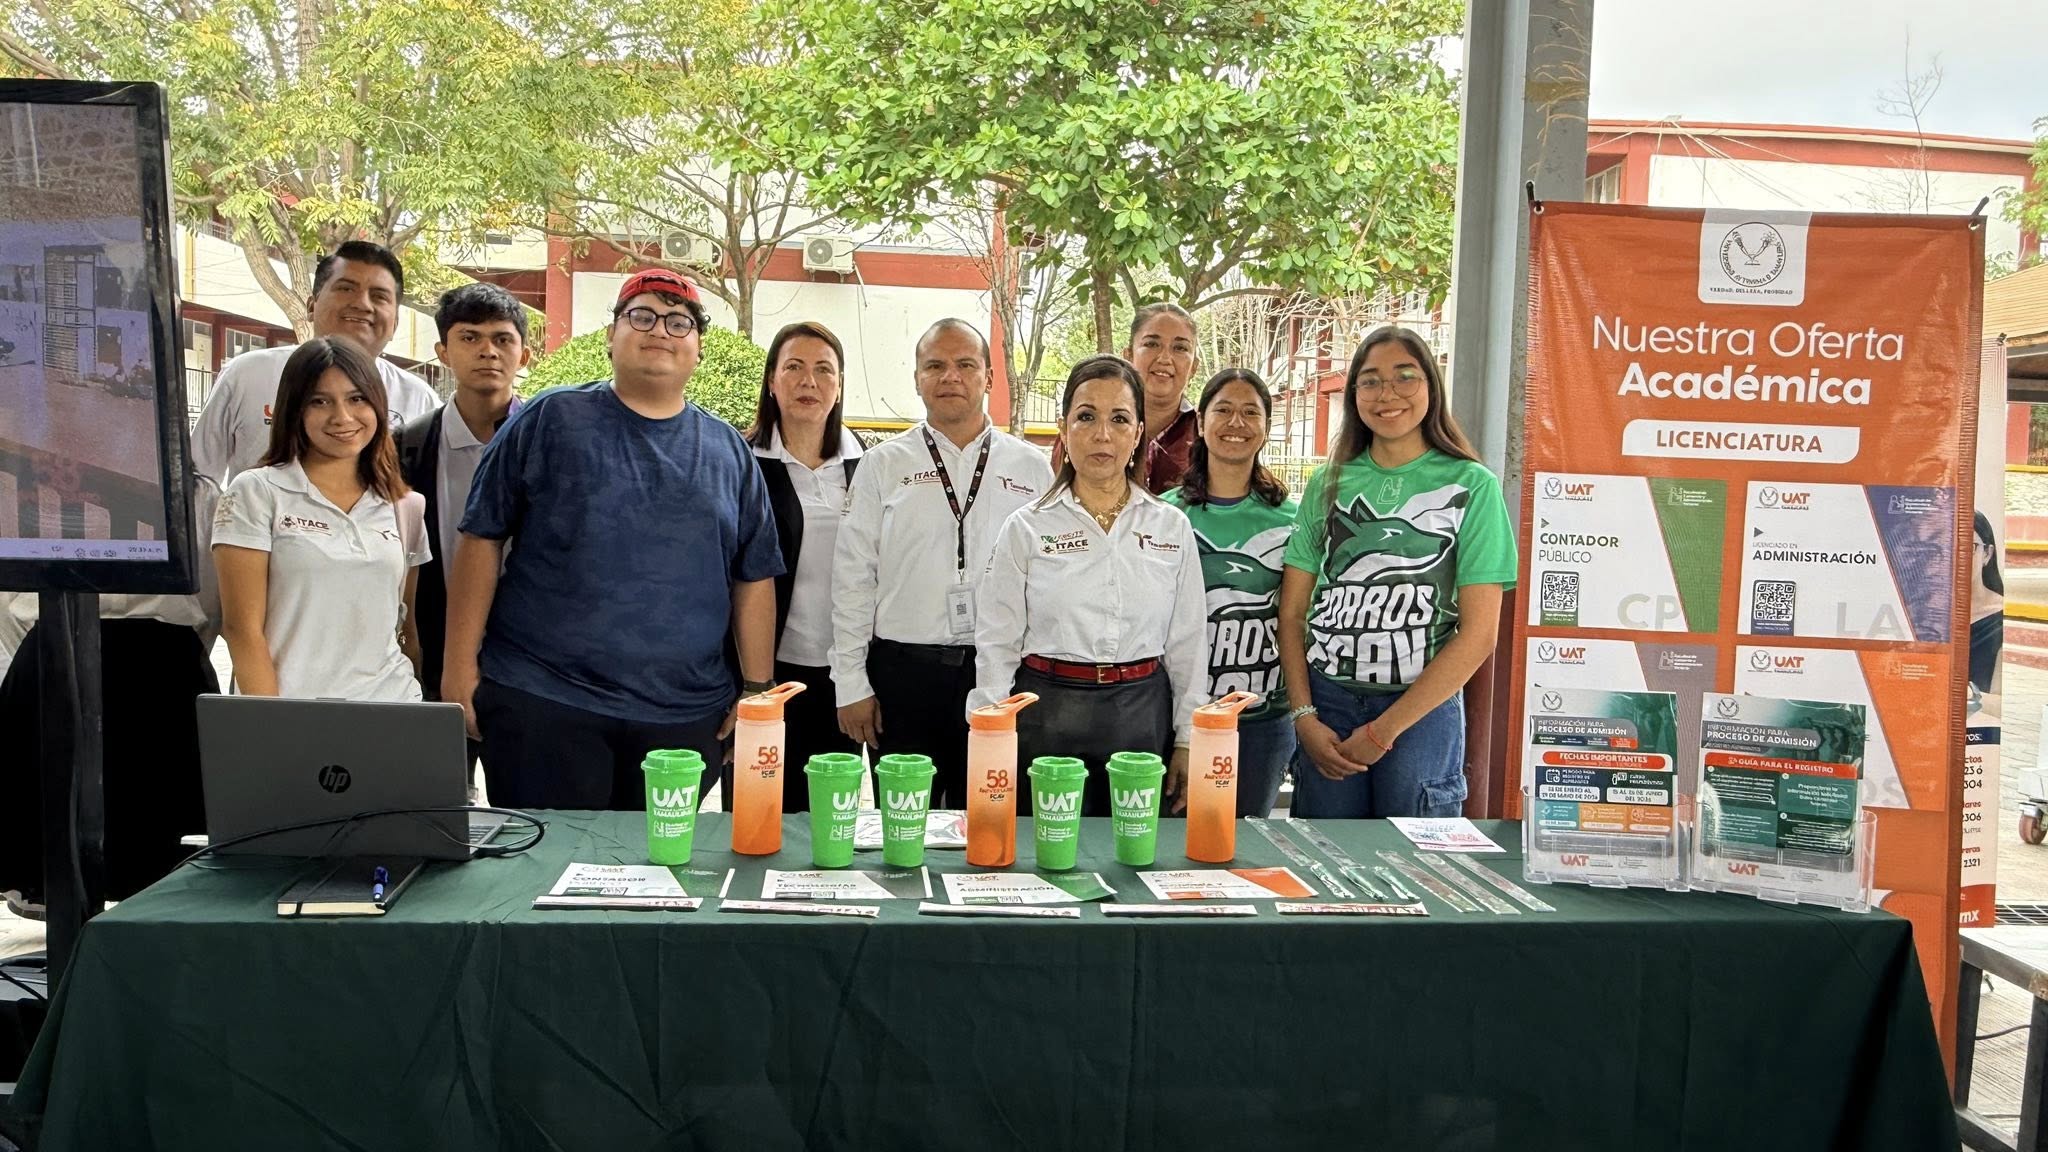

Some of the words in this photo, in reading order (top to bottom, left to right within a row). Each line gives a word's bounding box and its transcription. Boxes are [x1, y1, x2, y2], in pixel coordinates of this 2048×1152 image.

[1593, 315, 1755, 357] Nuestra
[1769, 321, 1904, 361] Oferta
[1617, 362, 1871, 405] Académica
[1655, 429, 1823, 453] LICENCIATURA
[1564, 483, 1594, 495] UAT
[1781, 492, 1811, 504] UAT
[1056, 539, 1089, 550] ITACE
[1540, 533, 1619, 548] CONTADOR
[1538, 547, 1592, 564] PÚBLICO
[1752, 550, 1877, 565] ADMINISTRACIÓN
[1617, 593, 1681, 630] CP
[1836, 601, 1906, 639] LA
[1559, 647, 1586, 659] UAT
[1774, 656, 1805, 668] UAT
[1586, 727, 1627, 735] ADMISIÓN
[1707, 731, 1750, 741] PROCESO
[1752, 734, 1765, 743] DE
[1766, 736, 1817, 748] ADMISIÓN
[758, 745, 778, 765] 58
[1559, 752, 1590, 761] FECHAS
[1590, 753, 1648, 764] IMPORTANTES
[1212, 756, 1233, 775] 58
[1738, 757, 1759, 766] GUÍA
[1760, 760, 1782, 769] PARA
[1794, 763, 1834, 774] REGISTRO
[322, 765, 348, 793] hp
[986, 769, 1009, 788] 58
[652, 784, 697, 808] UAT
[832, 788, 860, 811] UA
[886, 789, 929, 811] UAT
[1038, 790, 1080, 812] UAT
[1114, 787, 1156, 809] UAT
[1039, 811, 1077, 821] TAMAULIPAS
[1560, 854, 1590, 866] UAT
[1727, 862, 1760, 876] UAT
